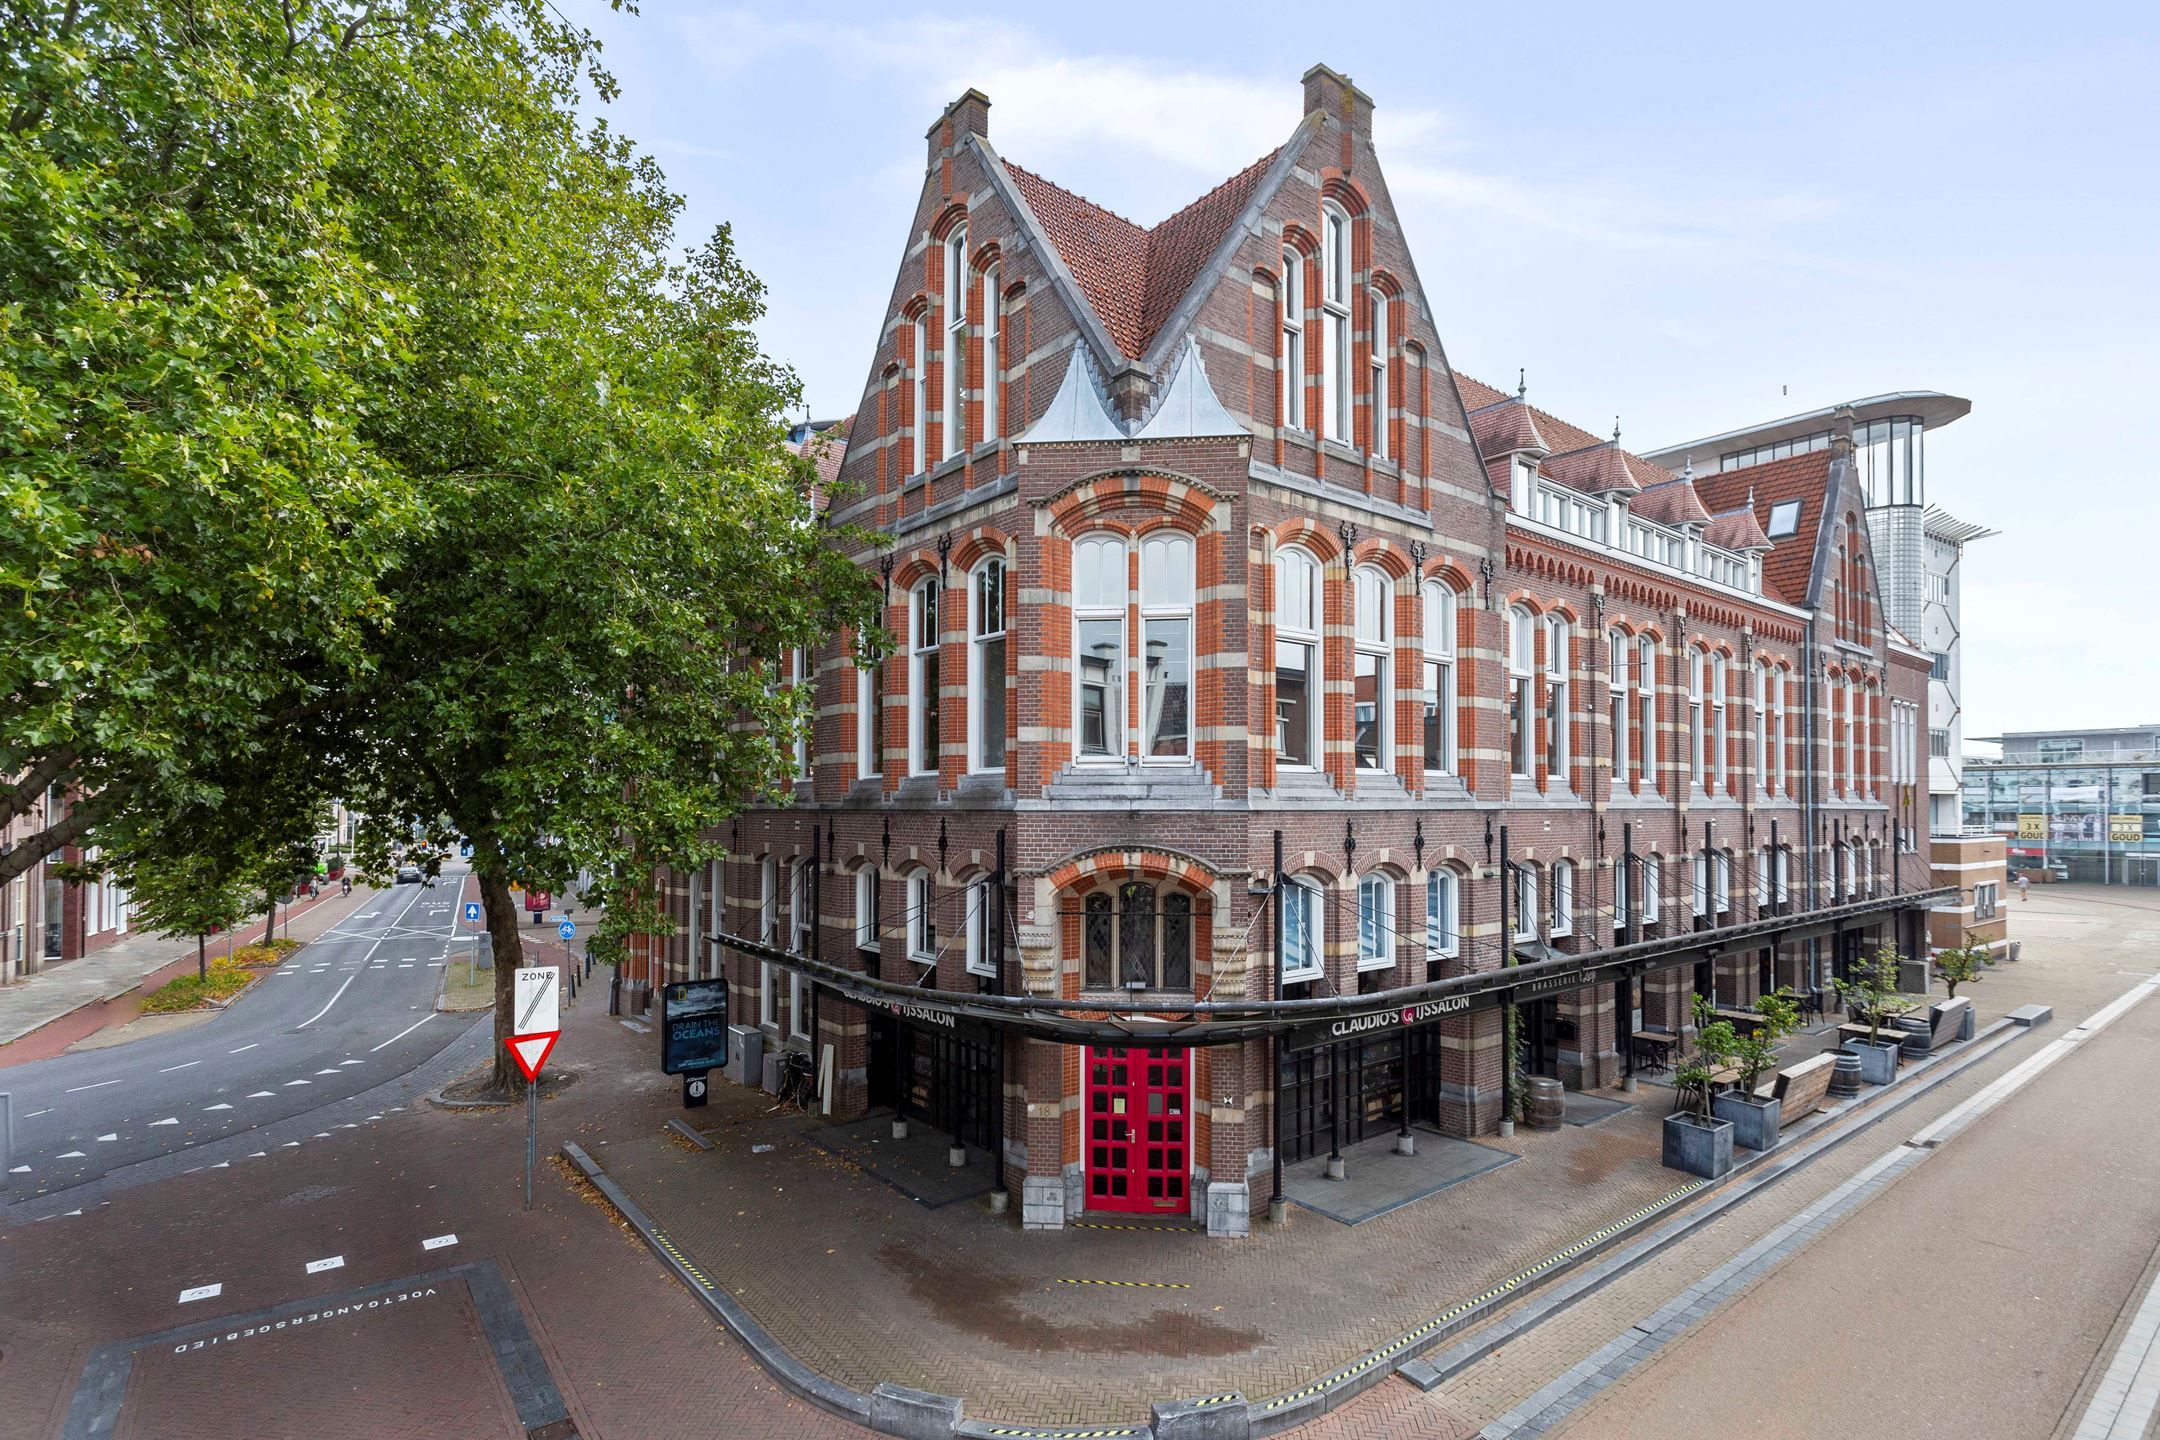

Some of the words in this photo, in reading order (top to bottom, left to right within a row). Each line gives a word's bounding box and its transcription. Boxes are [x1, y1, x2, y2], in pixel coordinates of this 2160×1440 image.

[2112, 833, 2140, 841] GOUD
[522, 971, 553, 981] ZONE
[1532, 975, 1575, 991] BRASSERIE
[903, 1005, 955, 1028] IJSSALON
[1332, 1011, 1399, 1036] CLAUDIO'S
[1416, 996, 1470, 1020] IJSSALON
[672, 1021, 700, 1031] DRAIN
[704, 1019, 720, 1027] THE
[672, 1026, 721, 1040] OCEANS
[174, 1288, 436, 1354] VOETGANGERSGEBIED
